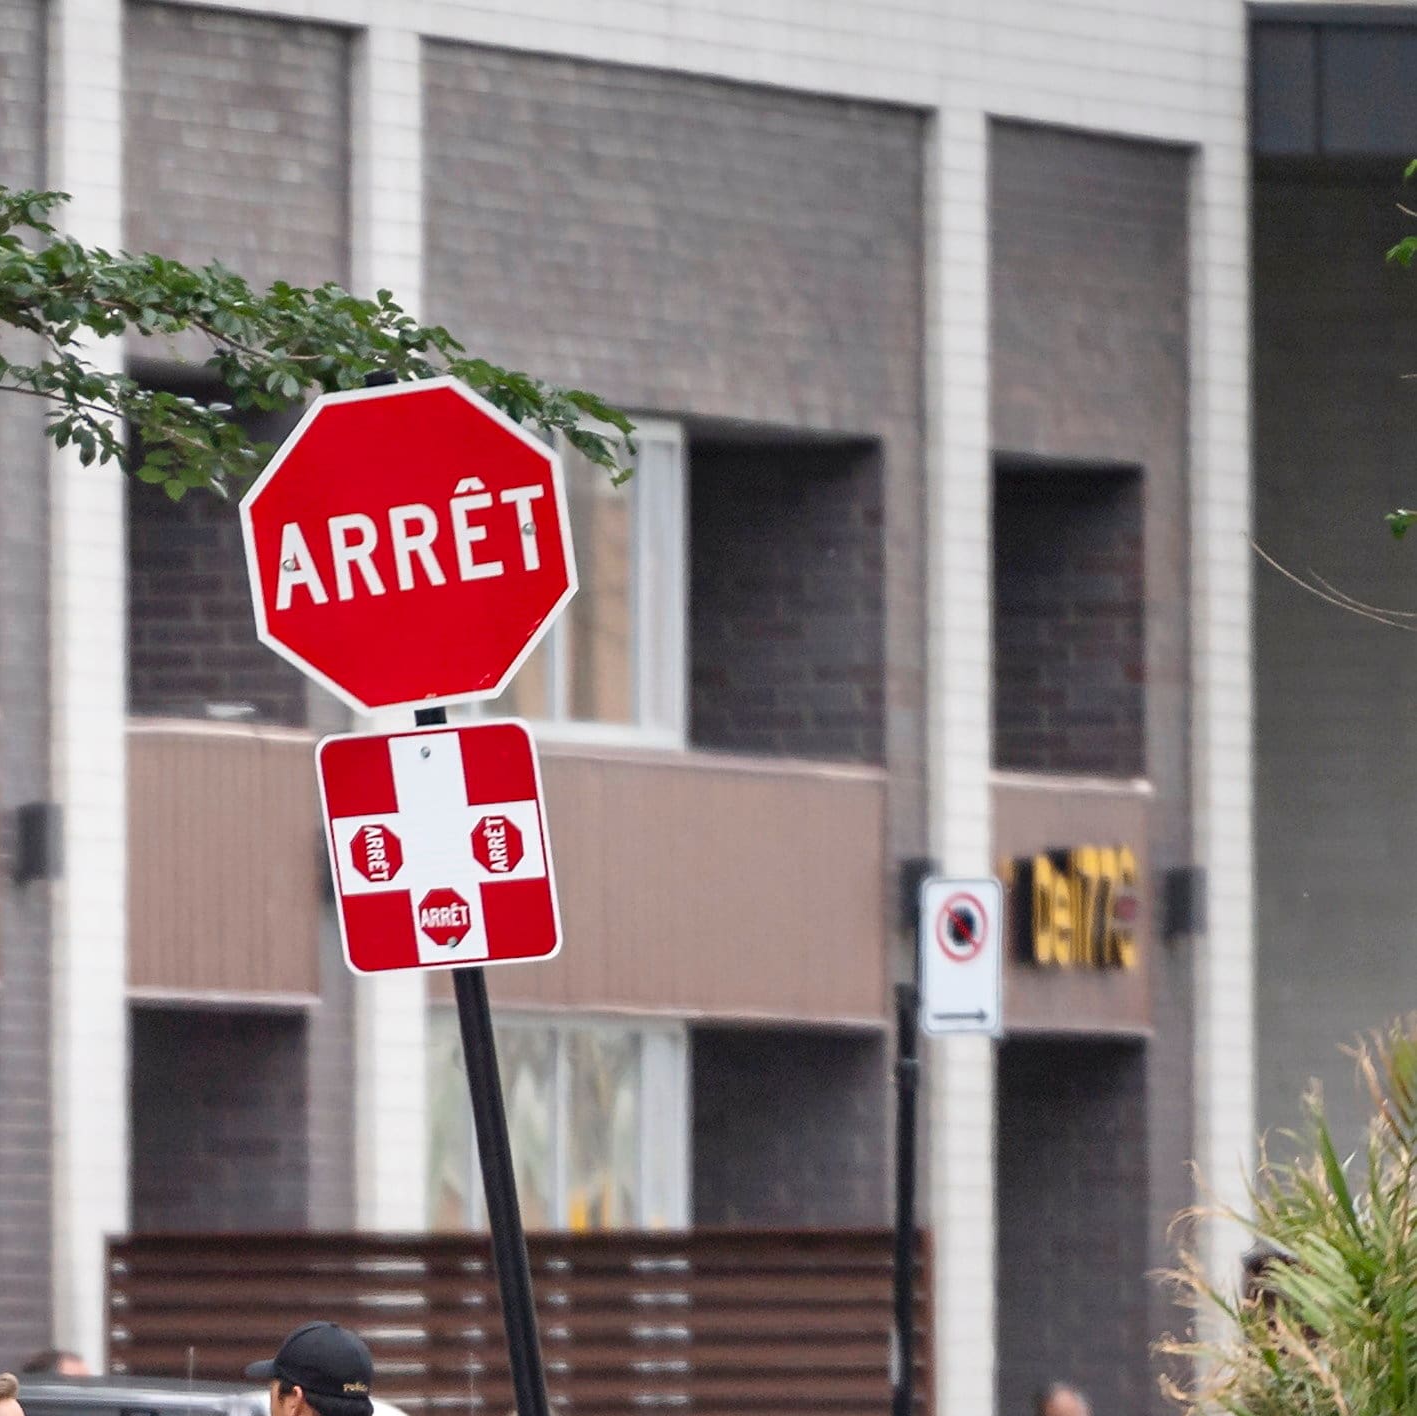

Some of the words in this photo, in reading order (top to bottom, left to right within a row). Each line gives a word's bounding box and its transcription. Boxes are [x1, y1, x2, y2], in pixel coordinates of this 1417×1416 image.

[275, 477, 545, 611] ARRÊT
[363, 826, 390, 881] ARRÊT
[483, 816, 510, 873] ARRÊT
[420, 901, 469, 928] ARRÊT
